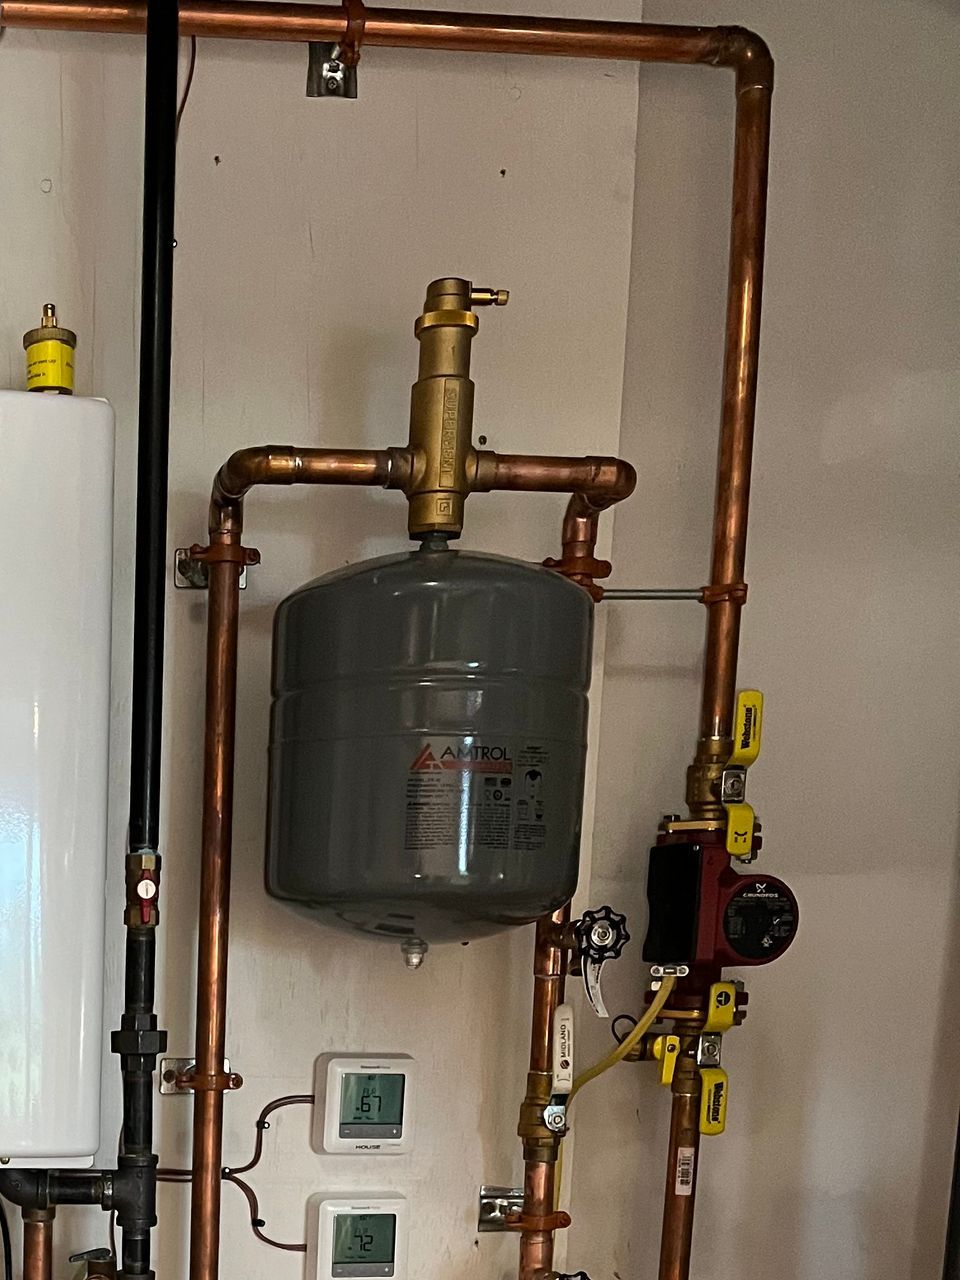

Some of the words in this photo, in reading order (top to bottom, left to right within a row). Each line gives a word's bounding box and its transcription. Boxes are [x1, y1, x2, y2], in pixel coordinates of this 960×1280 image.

[741, 707, 752, 749] Webstone
[440, 746, 512, 760] AMTROL
[712, 1082, 724, 1122] Webstone
[354, 1235, 373, 1252] 72
